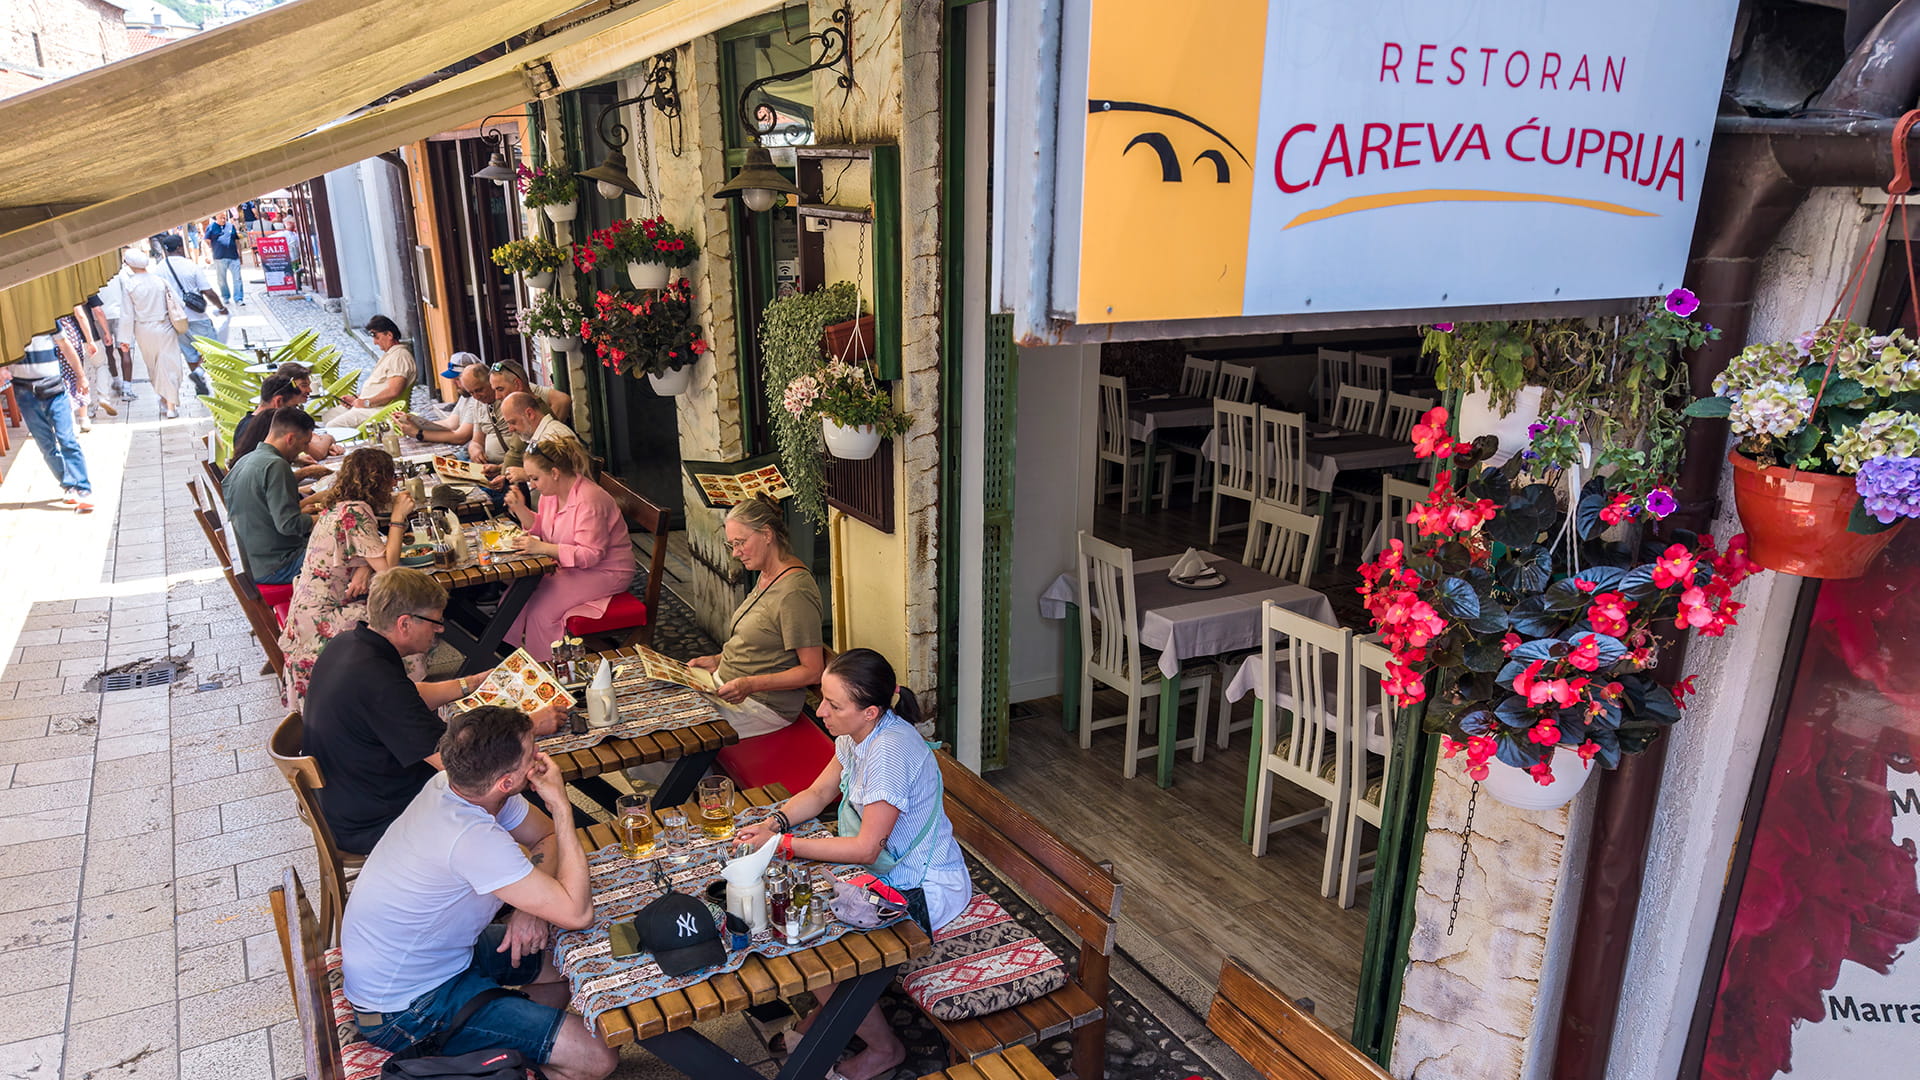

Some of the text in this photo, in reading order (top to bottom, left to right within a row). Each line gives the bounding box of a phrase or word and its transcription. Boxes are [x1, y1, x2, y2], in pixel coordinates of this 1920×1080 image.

[1379, 42, 1627, 93] RESTORAN
[1273, 117, 1685, 202] CAREVA ĆUPRIJA
[262, 245, 286, 254] SALE
[676, 912, 699, 938] NY
[1828, 995, 1920, 1024] Marra
